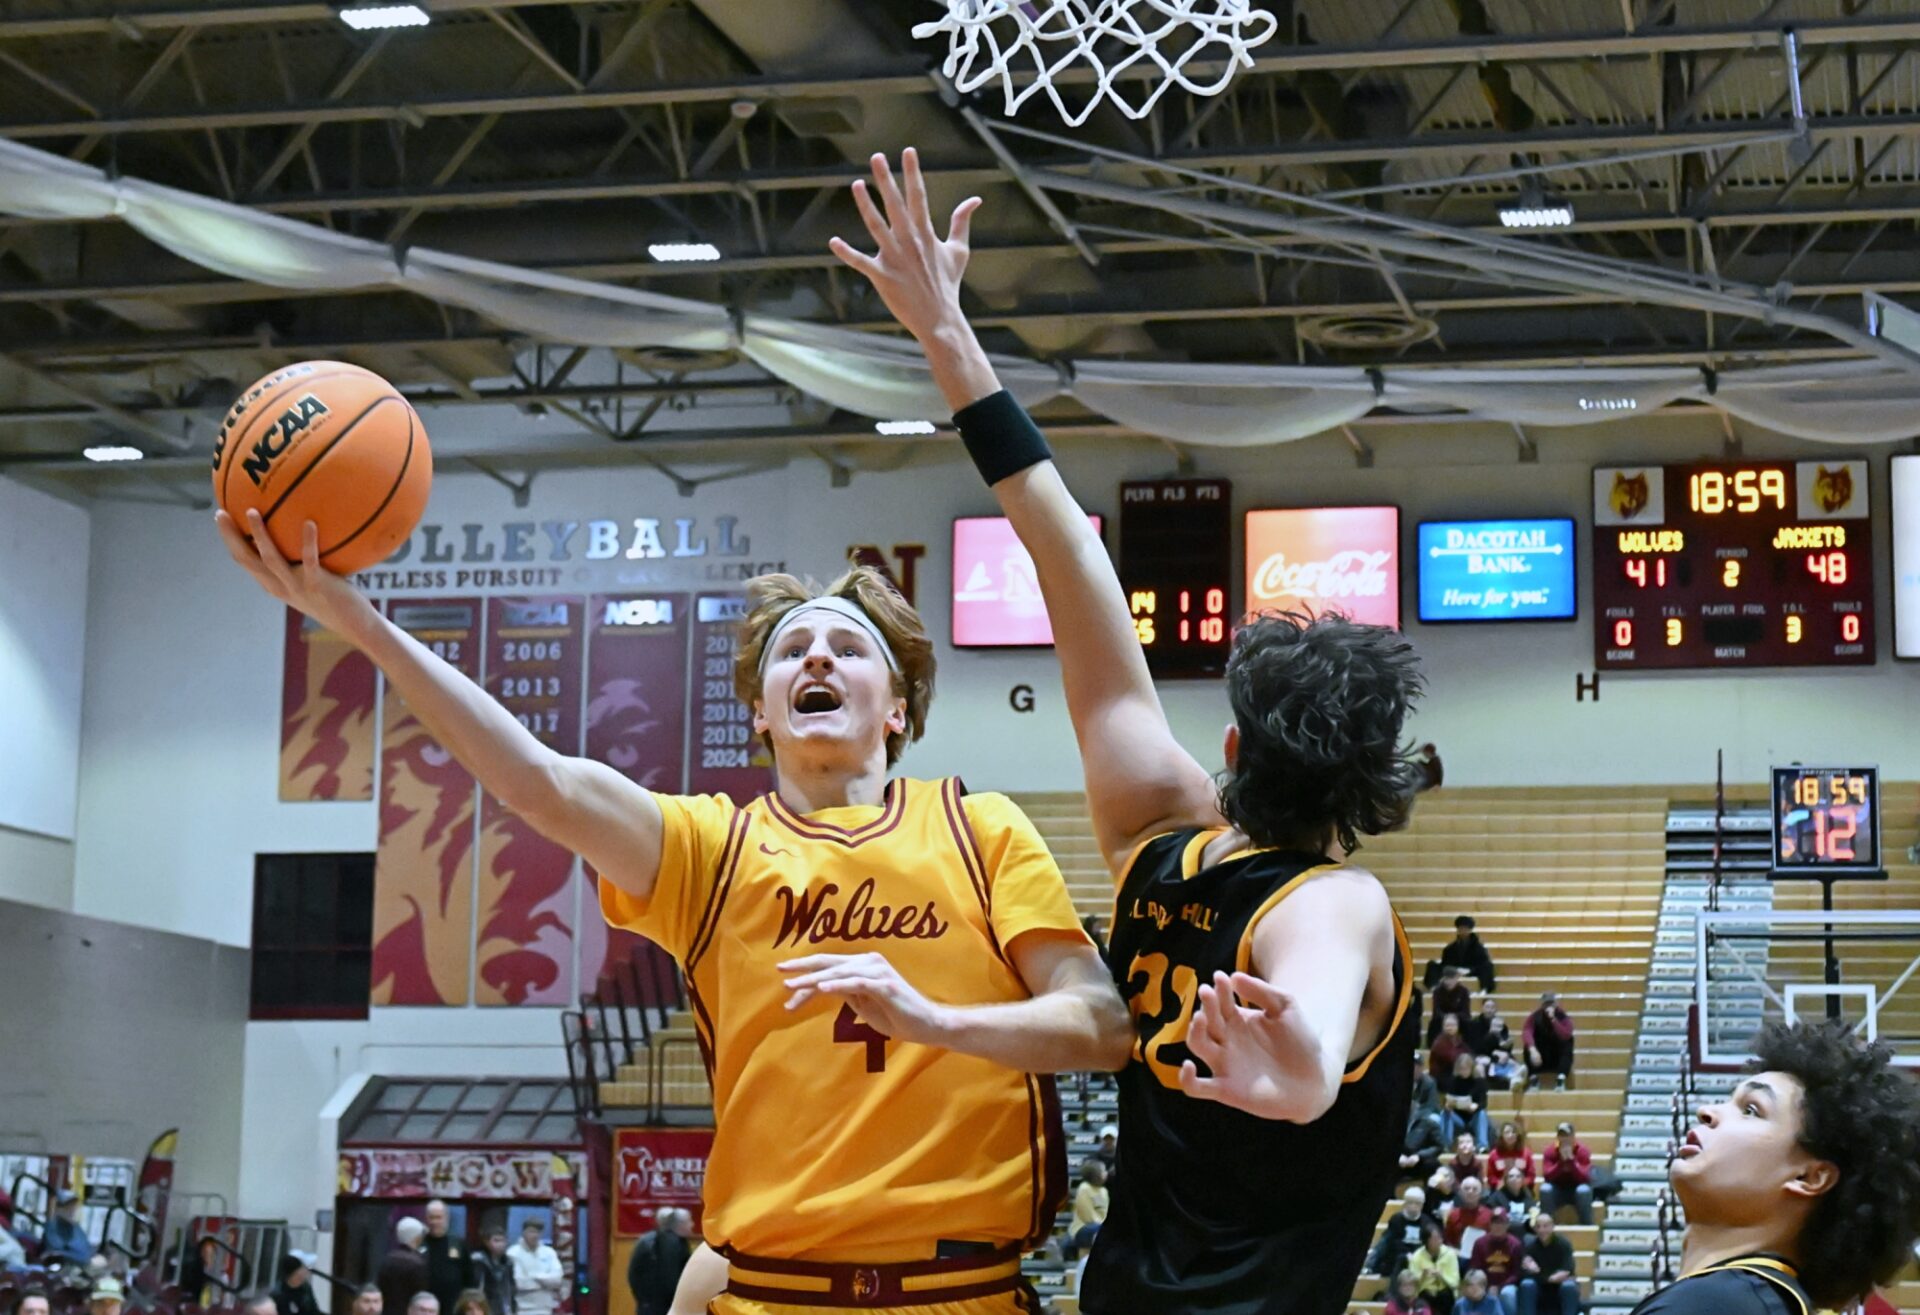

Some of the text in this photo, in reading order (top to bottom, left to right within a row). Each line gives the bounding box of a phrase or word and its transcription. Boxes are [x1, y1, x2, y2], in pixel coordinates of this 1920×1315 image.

[242, 393, 331, 487] NCAA
[1125, 487, 1155, 502] PLYR
[1196, 484, 1220, 501] PTS
[1691, 470, 1785, 513] 18:59
[383, 515, 748, 564] LLEYBALL
[1446, 529, 1547, 550] DACOTAH
[1619, 530, 1684, 553] WOLVES
[1773, 526, 1846, 549] JACKETS
[1715, 548, 1748, 558] PERIOD
[346, 571, 447, 590] NTLESS
[456, 567, 563, 588] PURSUIT
[1626, 559, 1666, 587] 41
[1723, 560, 1741, 587] 2
[1807, 553, 1847, 584] 48
[1207, 588, 1223, 614] 0
[1443, 588, 1481, 606] Here
[1481, 587, 1509, 609] for
[1833, 602, 1862, 612] FOULS
[1606, 608, 1634, 618] FOULS
[1702, 605, 1766, 616] PLAYER FOUL
[1200, 618, 1223, 643] 10
[1615, 620, 1632, 646] 0
[1667, 619, 1682, 646] 3
[1786, 615, 1801, 643] 3
[1843, 614, 1859, 641] 0
[503, 641, 562, 662] 2006
[1606, 650, 1634, 661] SCORE
[1715, 647, 1746, 658] MATCH
[1833, 644, 1863, 655] SCORE
[501, 678, 561, 698] 2013
[1009, 684, 1035, 713] G
[1577, 673, 1599, 701] H
[517, 708, 560, 733] 017
[703, 702, 750, 722] 2018
[703, 725, 750, 745] 2019
[702, 748, 750, 769] 2024
[1814, 808, 1857, 859] 12
[772, 877, 949, 949] Wolves
[1127, 951, 1198, 1091] 22
[832, 1001, 892, 1074] 4
[651, 1172, 668, 1187] &
